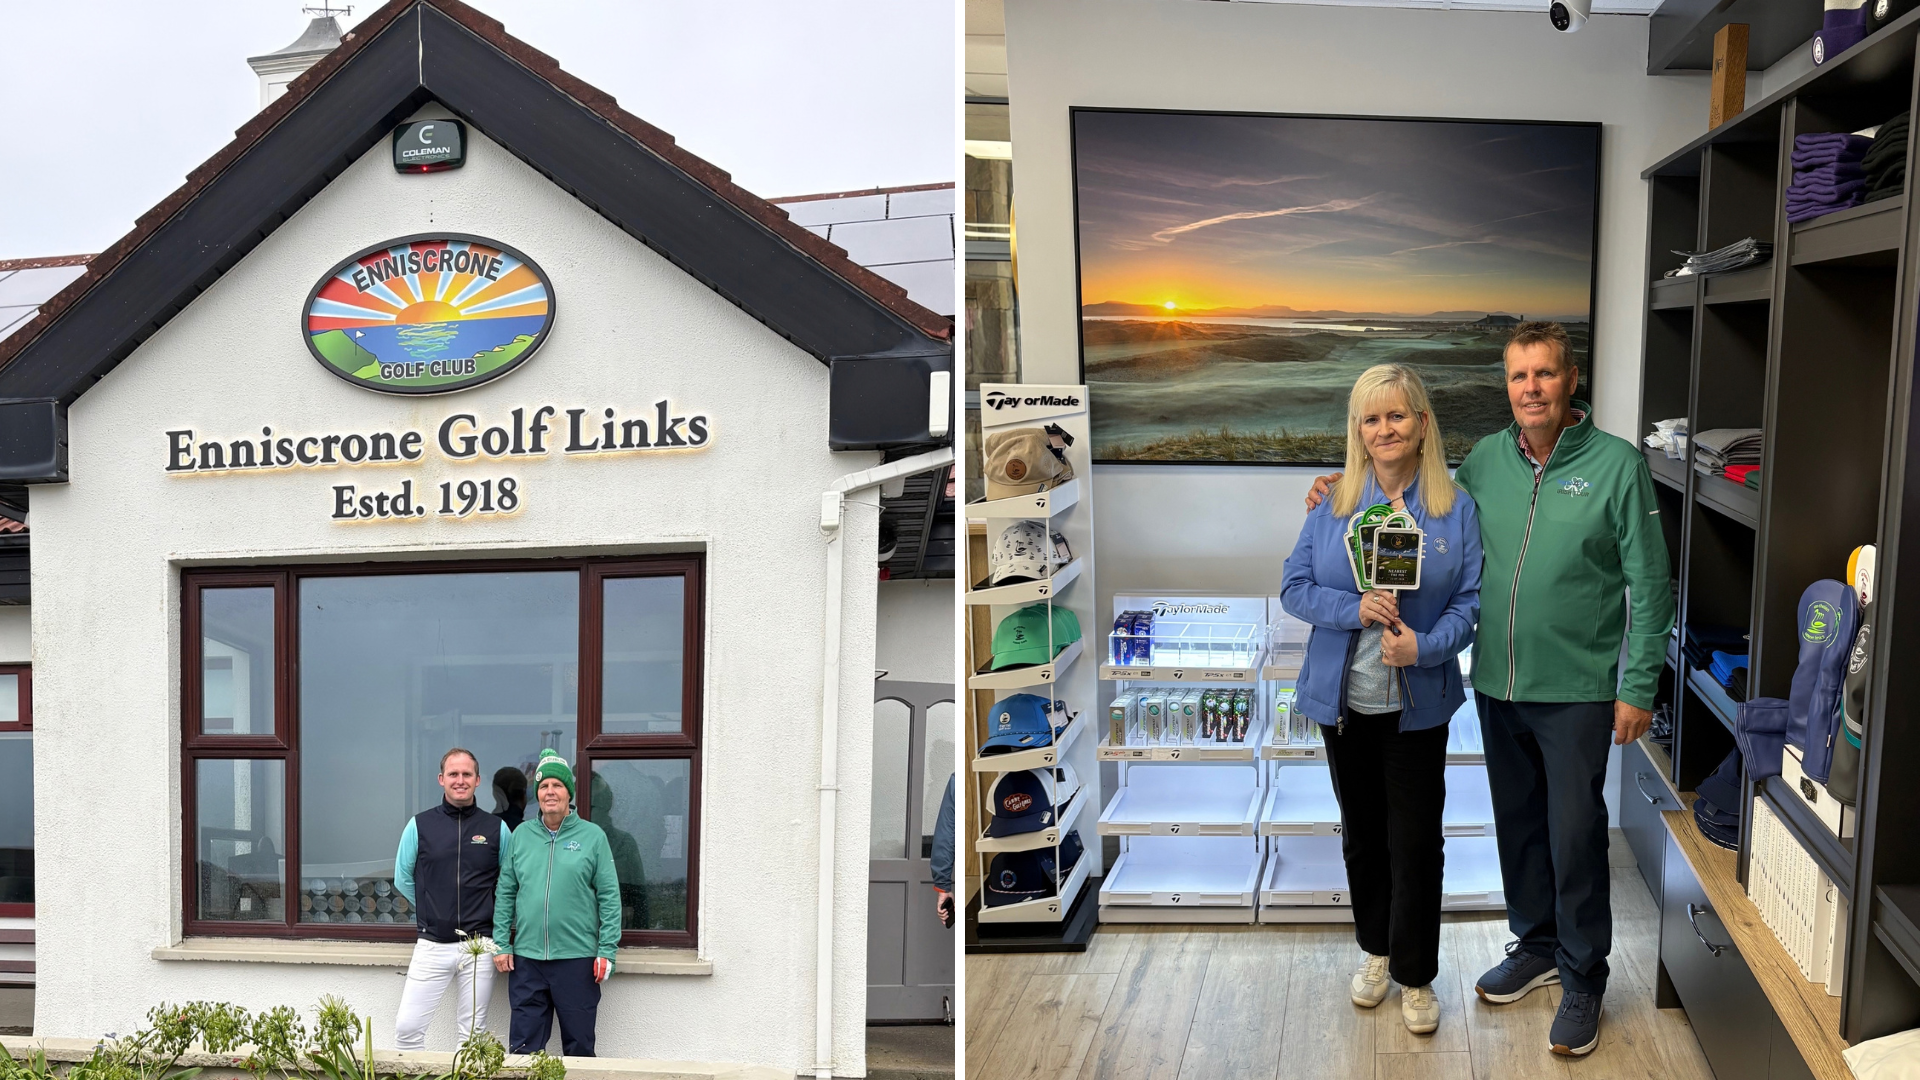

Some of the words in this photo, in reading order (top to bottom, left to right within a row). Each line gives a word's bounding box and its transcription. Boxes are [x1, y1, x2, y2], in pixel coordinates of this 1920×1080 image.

[402, 146, 451, 158] COLEMAN
[402, 153, 451, 163] ELECTRONICS
[352, 249, 503, 293] ENNISCRONE
[380, 362, 425, 379] GOLF
[430, 358, 476, 376] CLUB
[165, 426, 422, 472] Enniscrone
[438, 405, 555, 458] Golf
[564, 400, 708, 452] Links
[331, 479, 425, 518] Estd.
[438, 477, 517, 516] 1918
[1152, 600, 1228, 617] TaylorMade
